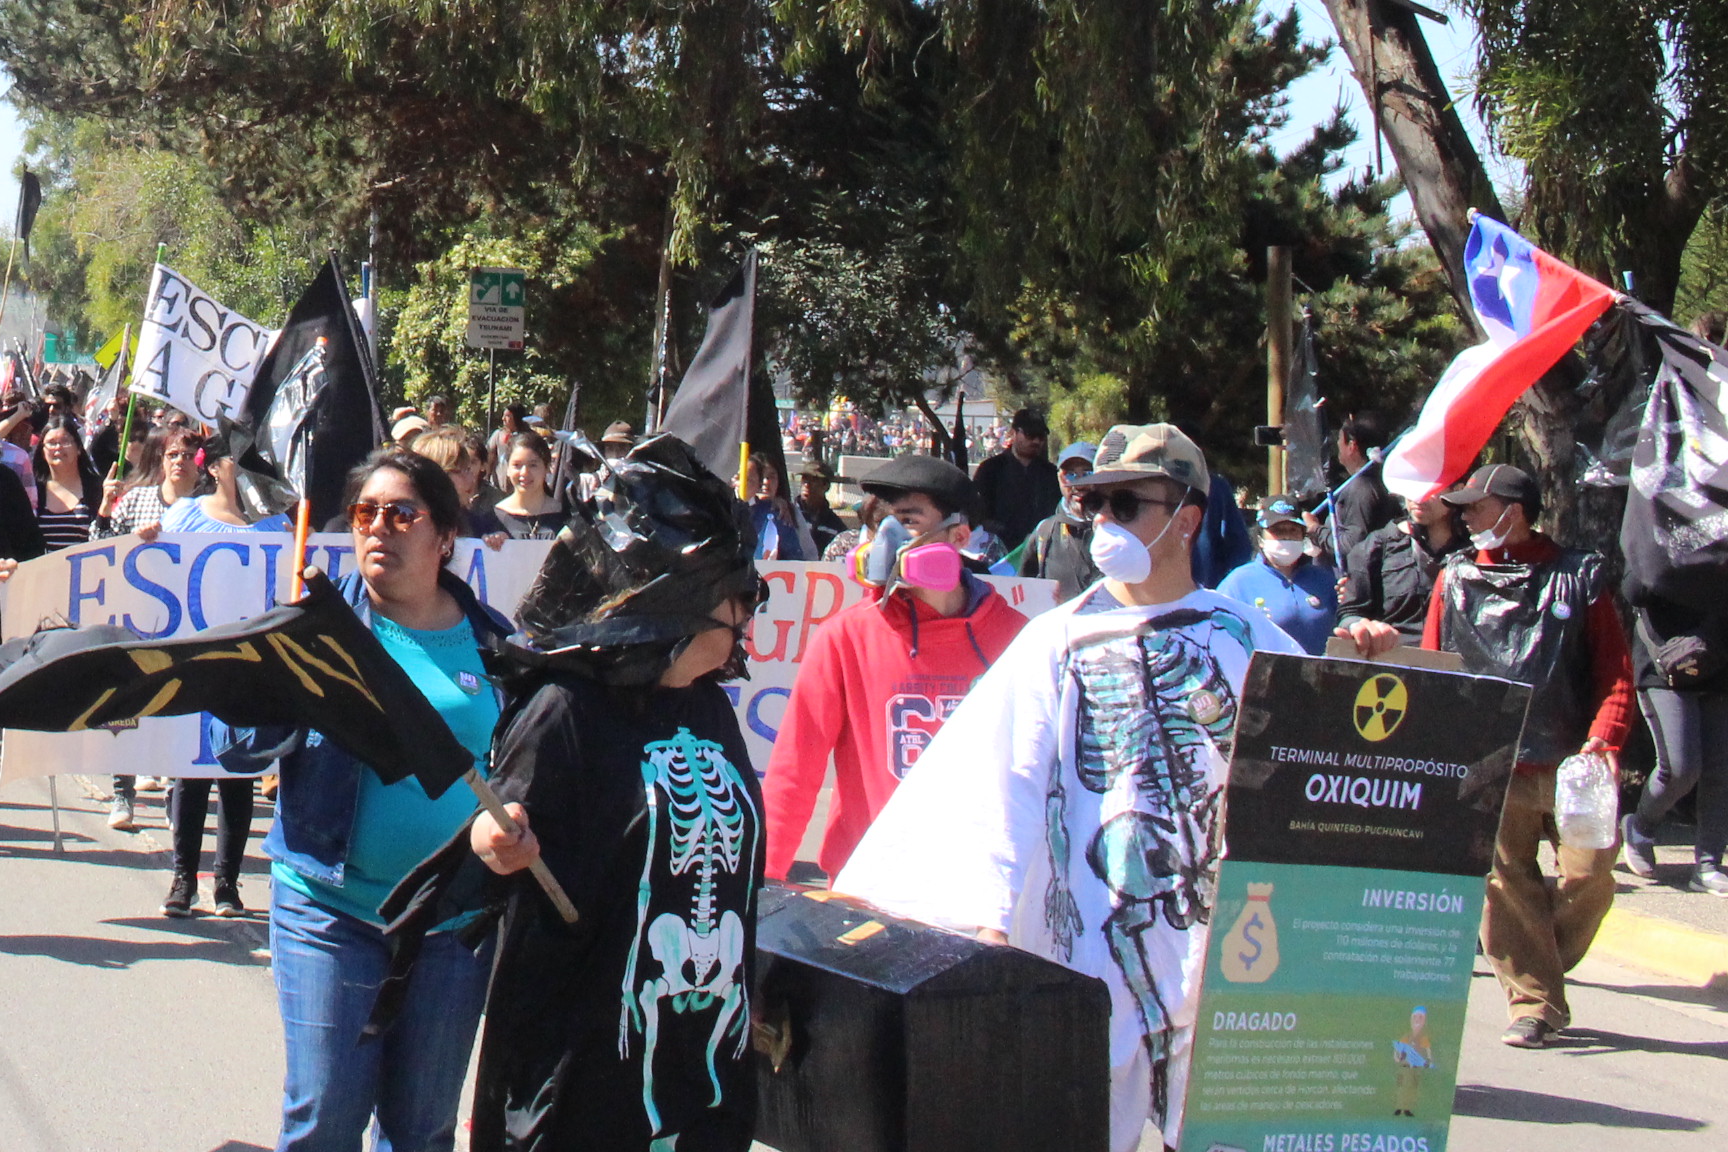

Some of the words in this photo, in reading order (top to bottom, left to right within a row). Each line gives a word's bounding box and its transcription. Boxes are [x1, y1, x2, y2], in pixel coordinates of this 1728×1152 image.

[479, 324, 513, 332] TSUNAMI
[67, 540, 490, 641] ESCUA
[1270, 746, 1340, 767] TERMINAL
[1343, 753, 1470, 779] MULTIPROPÓSITO
[1304, 773, 1422, 810] OXIQUIM
[1361, 888, 1464, 914] INVERSIÓN
[1213, 1011, 1297, 1031] DRAGADO
[1262, 1134, 1335, 1152] METALES
[1340, 1133, 1429, 1152] PESADOS
